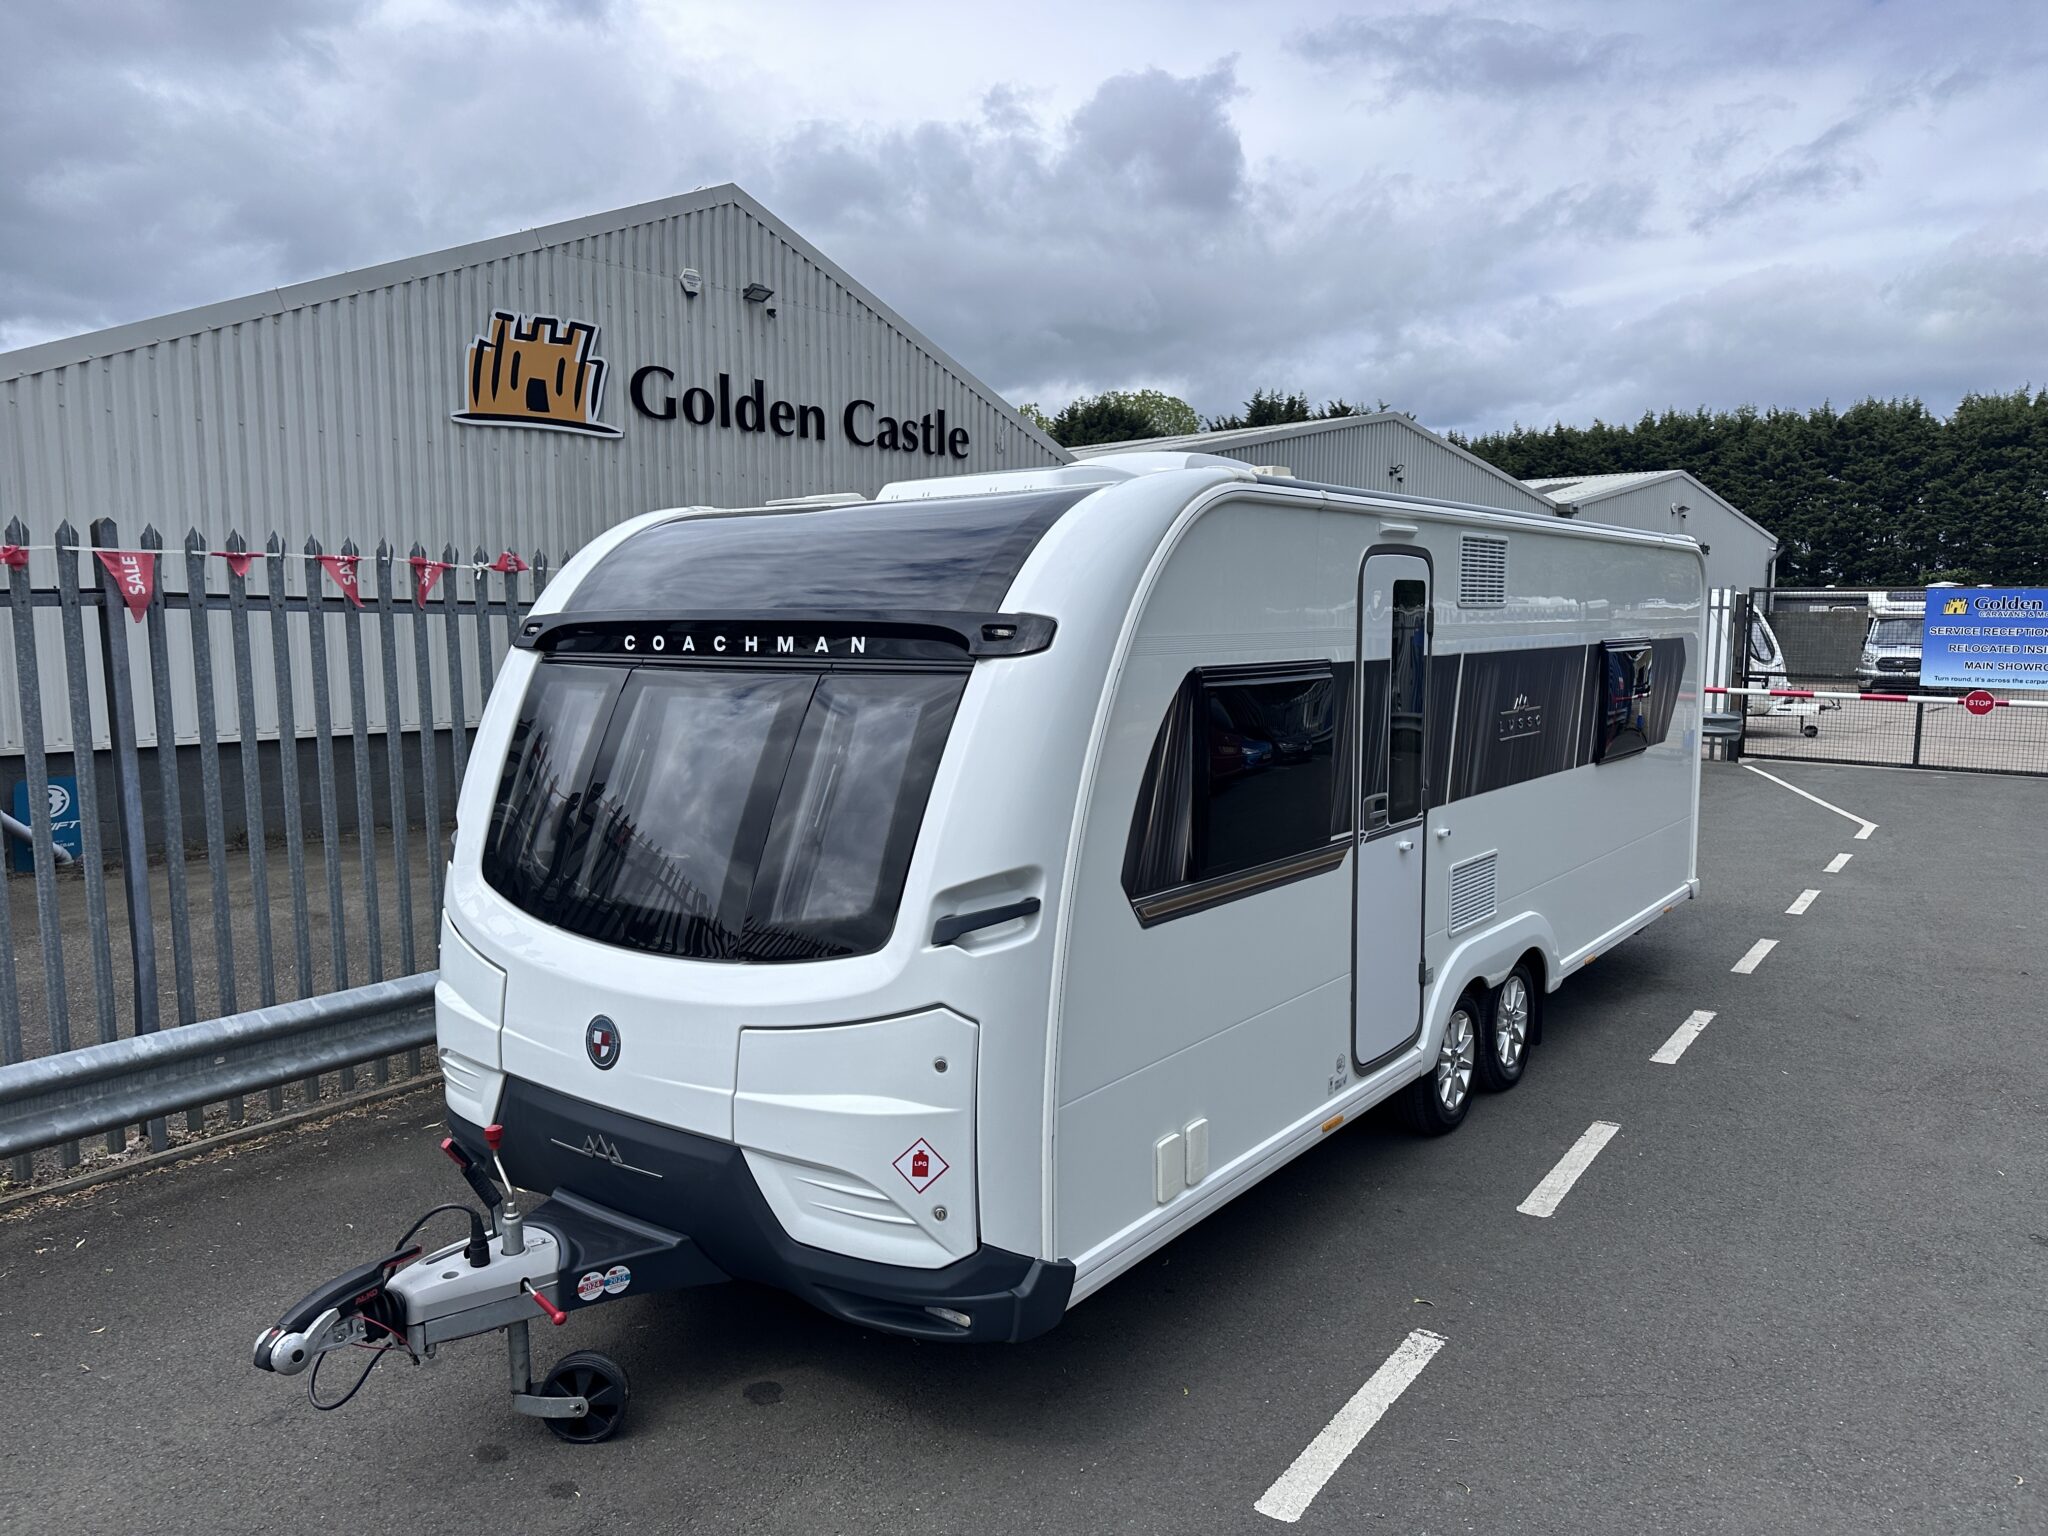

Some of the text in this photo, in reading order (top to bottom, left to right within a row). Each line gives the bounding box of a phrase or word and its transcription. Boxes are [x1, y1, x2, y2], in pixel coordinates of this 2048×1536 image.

[630, 365, 970, 460] Golden Castle
[121, 556, 146, 595] SALE
[1974, 596, 2043, 611] Golden
[1979, 610, 2026, 618] CARAVANS
[1930, 627, 1979, 636] SERVICE
[624, 635, 866, 654] COACHMAN
[1948, 644, 2020, 654] RELOCATED
[1964, 661, 1994, 670] MAIN
[1968, 699, 1992, 707] STOP
